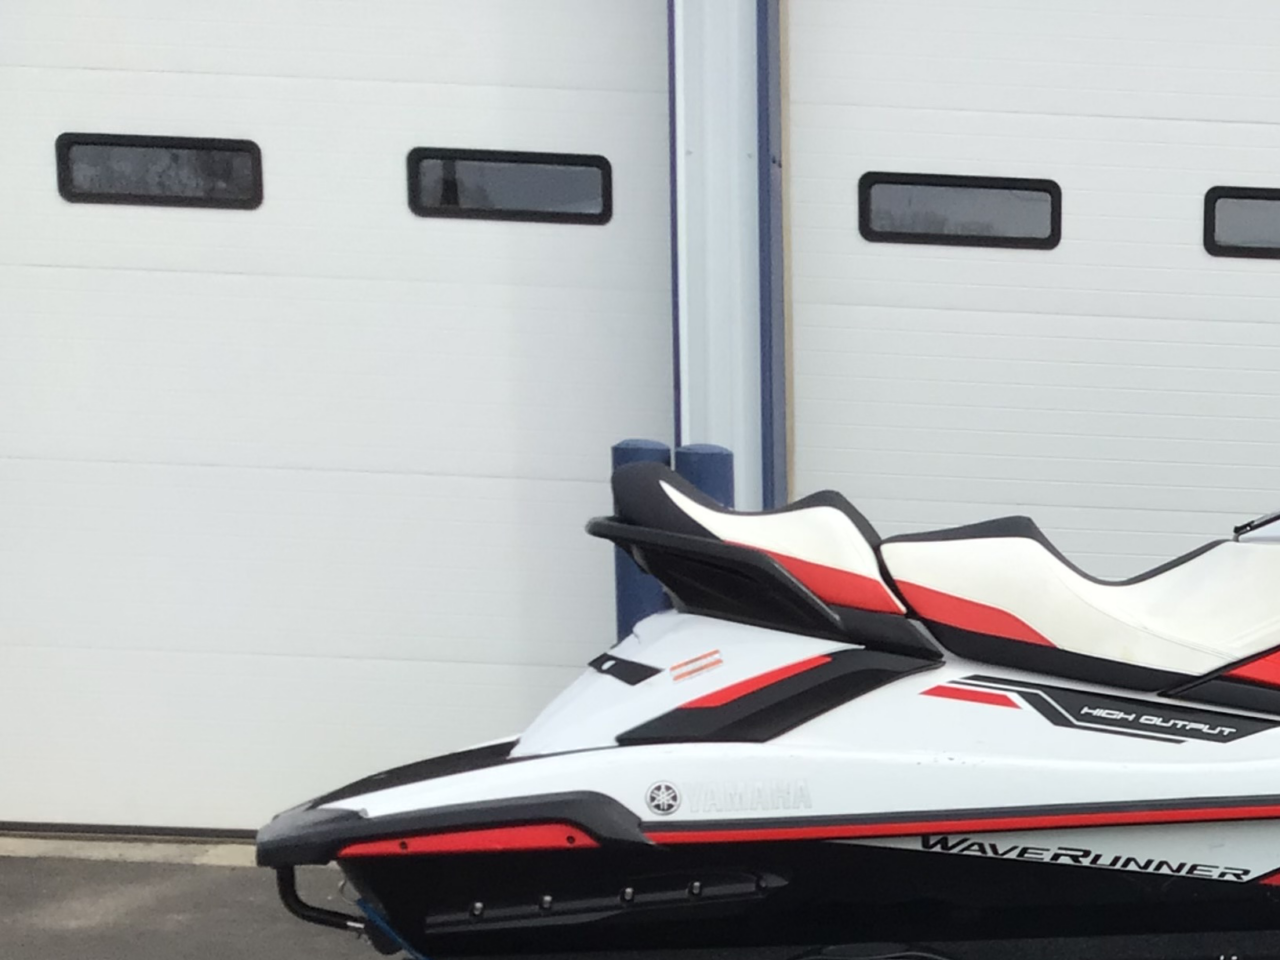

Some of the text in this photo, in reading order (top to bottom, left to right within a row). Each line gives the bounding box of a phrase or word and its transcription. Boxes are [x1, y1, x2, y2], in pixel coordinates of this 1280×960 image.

[1080, 706, 1236, 736] HIGH OUTPUT
[682, 778, 813, 813] YAMAHA
